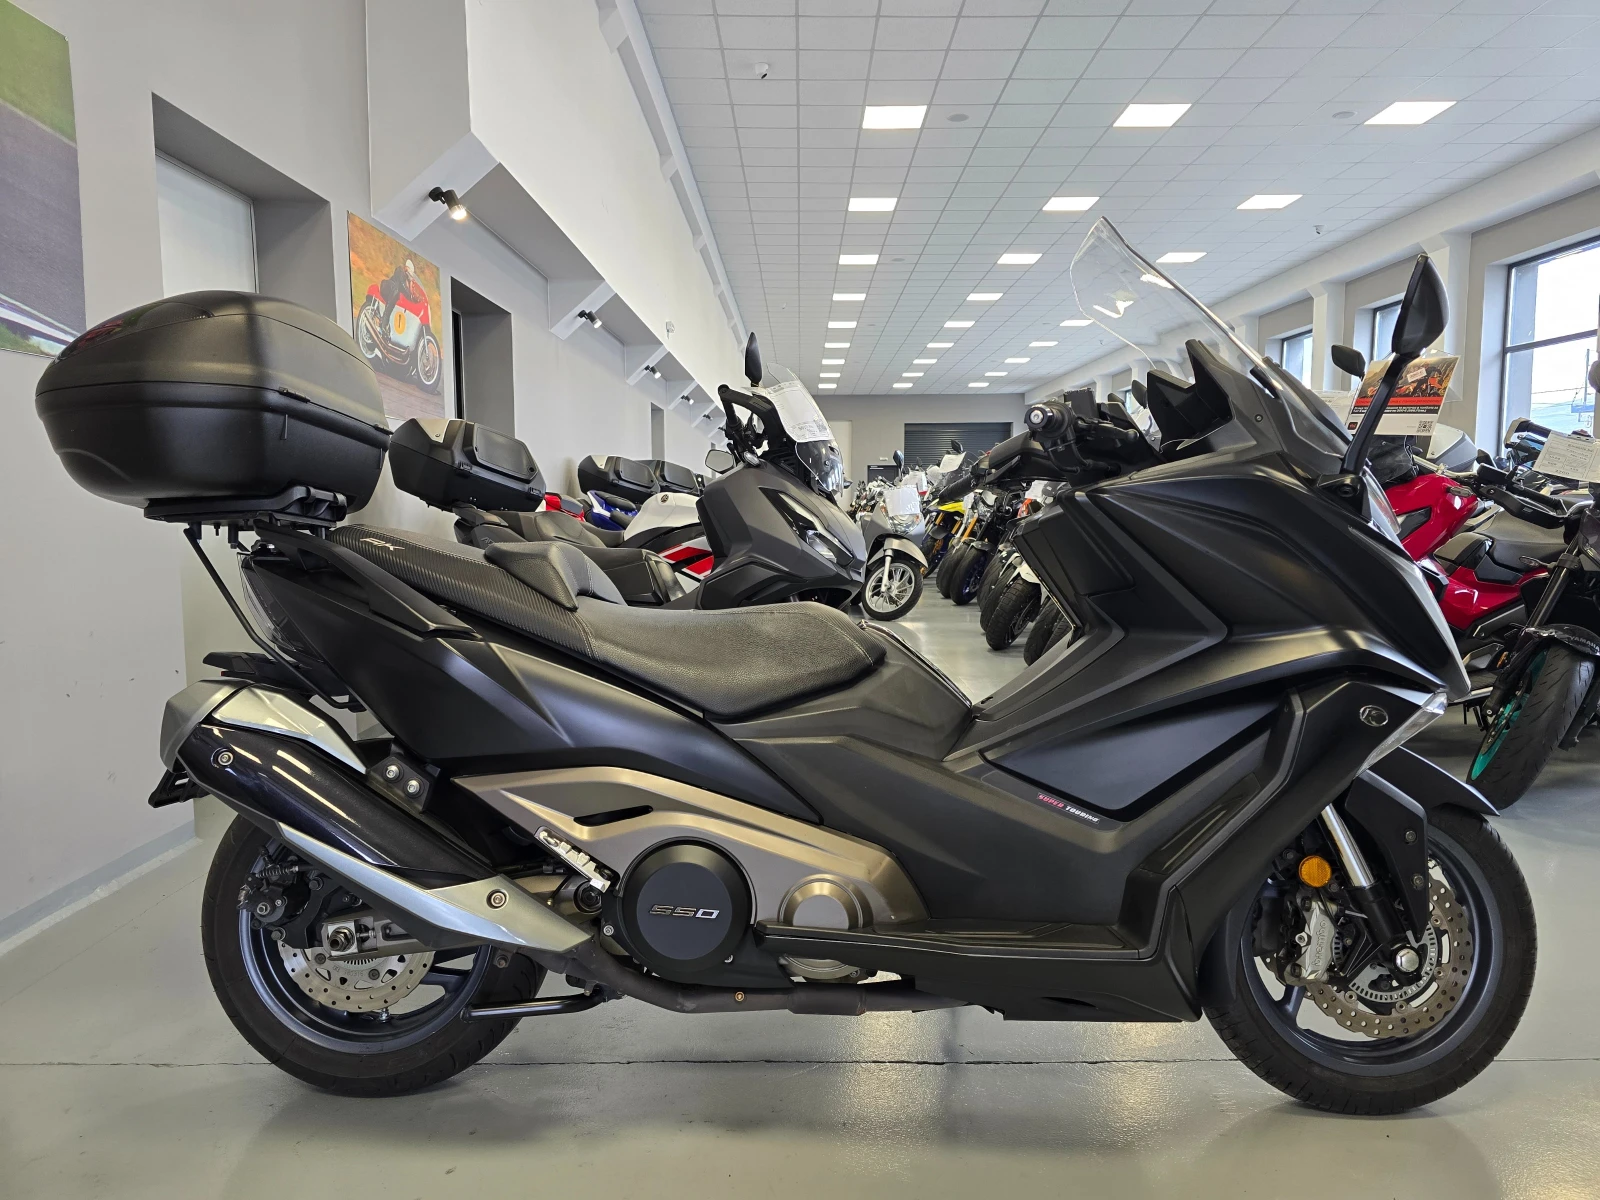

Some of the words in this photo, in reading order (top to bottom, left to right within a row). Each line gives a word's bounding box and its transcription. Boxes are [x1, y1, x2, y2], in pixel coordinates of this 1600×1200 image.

[1570, 635, 1600, 652] YAMAHA
[1038, 794, 1065, 808] SUPER
[1065, 805, 1100, 822] TOURING
[649, 904, 720, 919] 550
[1312, 920, 1326, 966] brembo
